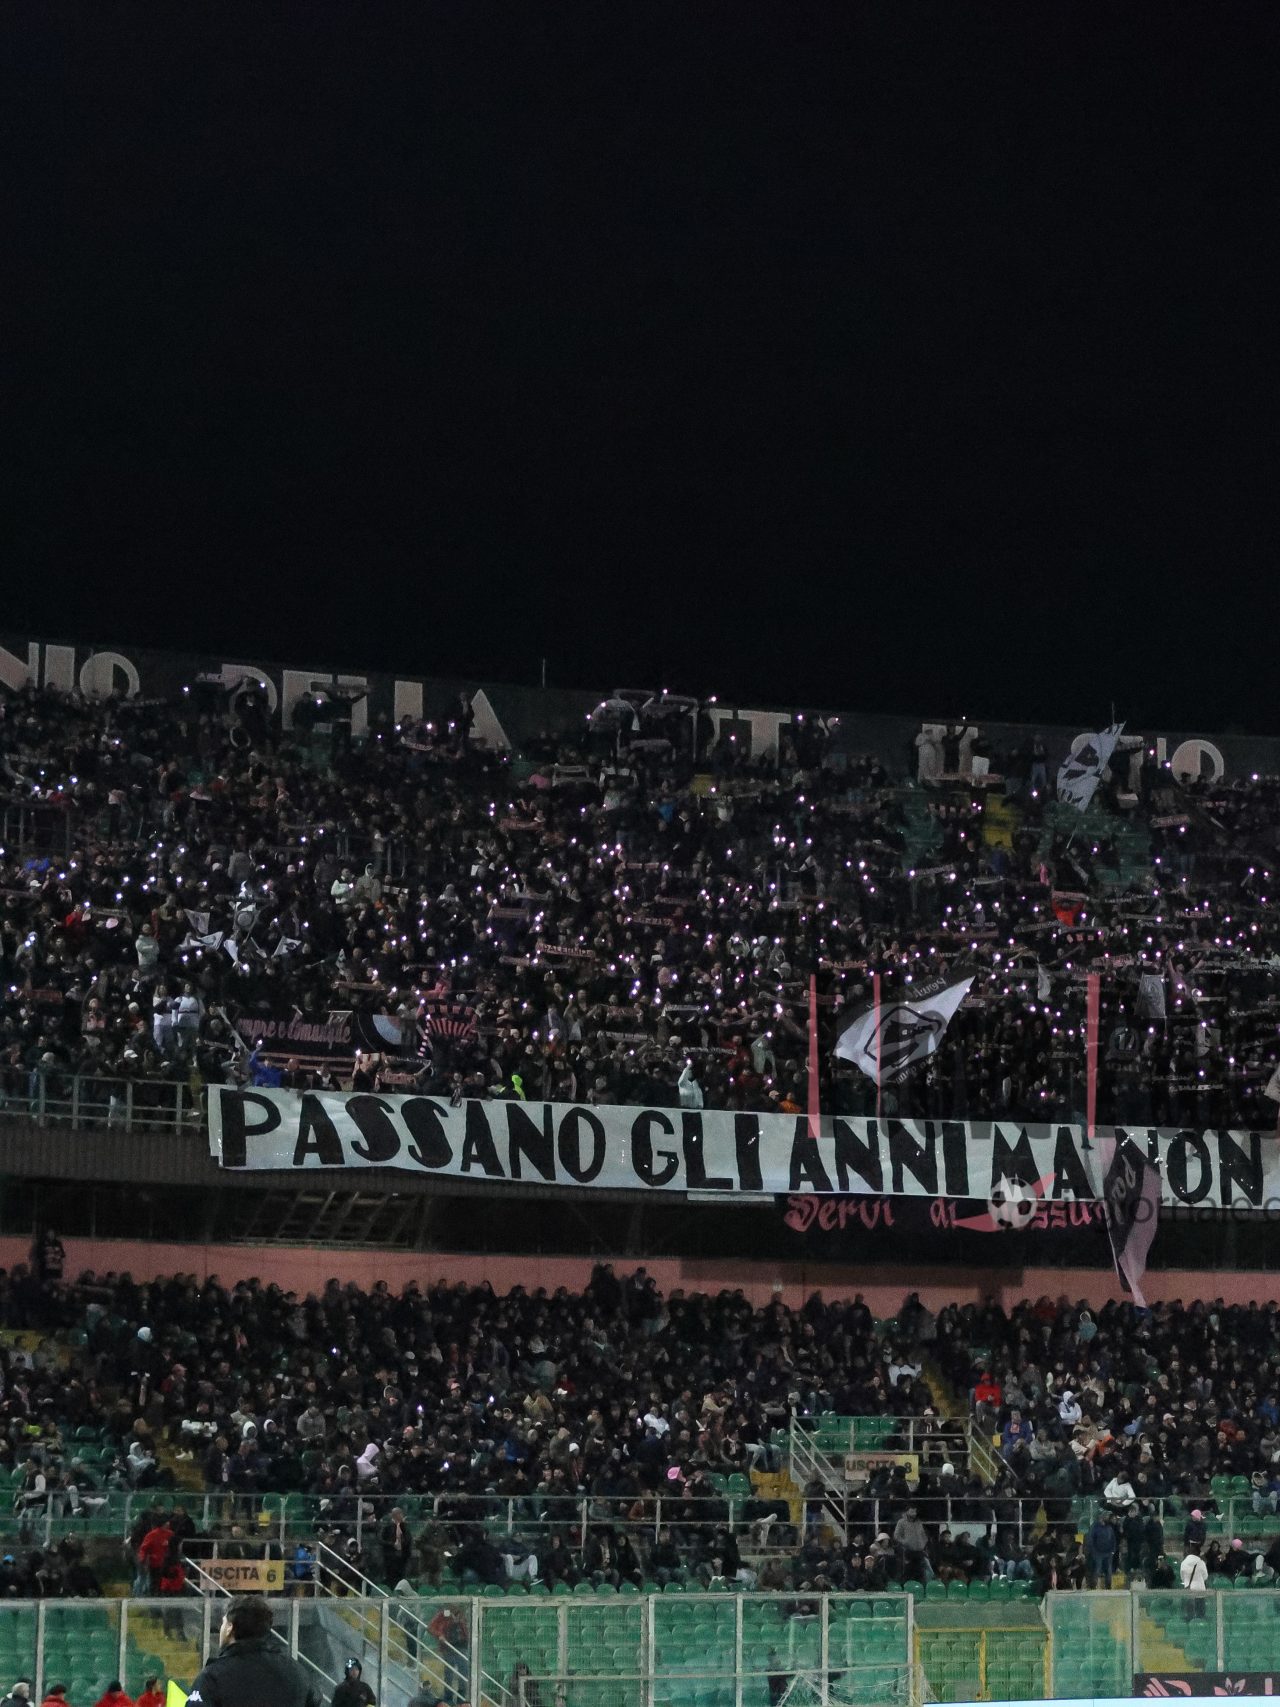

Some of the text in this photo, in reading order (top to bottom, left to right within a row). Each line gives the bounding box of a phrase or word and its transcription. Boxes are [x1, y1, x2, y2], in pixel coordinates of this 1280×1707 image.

[221, 1090, 606, 1184] PASSANO
[631, 1109, 763, 1190] GLI
[789, 1116, 970, 1196] ANNI
[991, 1124, 1097, 1202] MA
[1113, 1129, 1264, 1207] NON
[266, 1569, 277, 1583] 6
